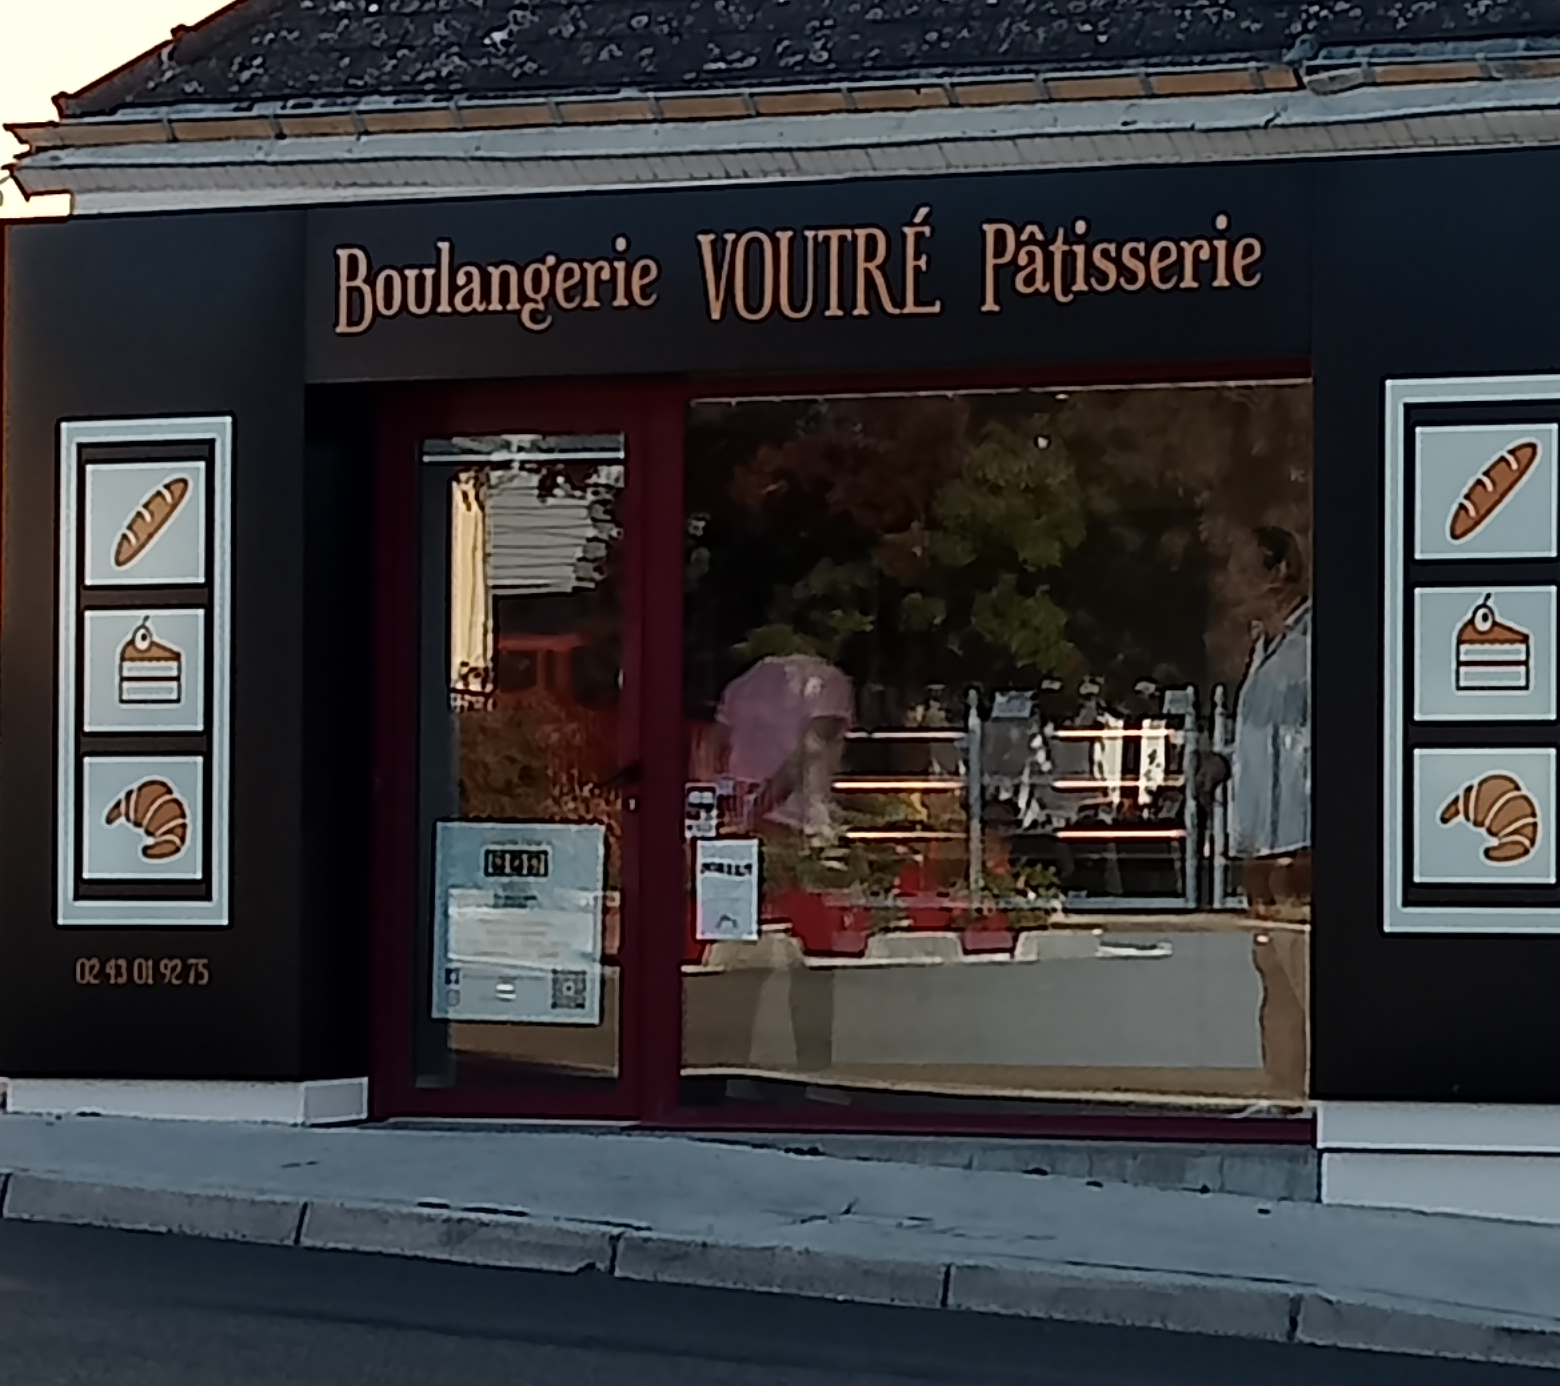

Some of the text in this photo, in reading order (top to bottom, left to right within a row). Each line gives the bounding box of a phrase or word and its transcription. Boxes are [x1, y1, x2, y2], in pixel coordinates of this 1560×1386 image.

[334, 208, 1264, 335] Boulangerie VOUTRÉ Pâtisserie
[75, 957, 210, 985] 02 43 01 92 75
